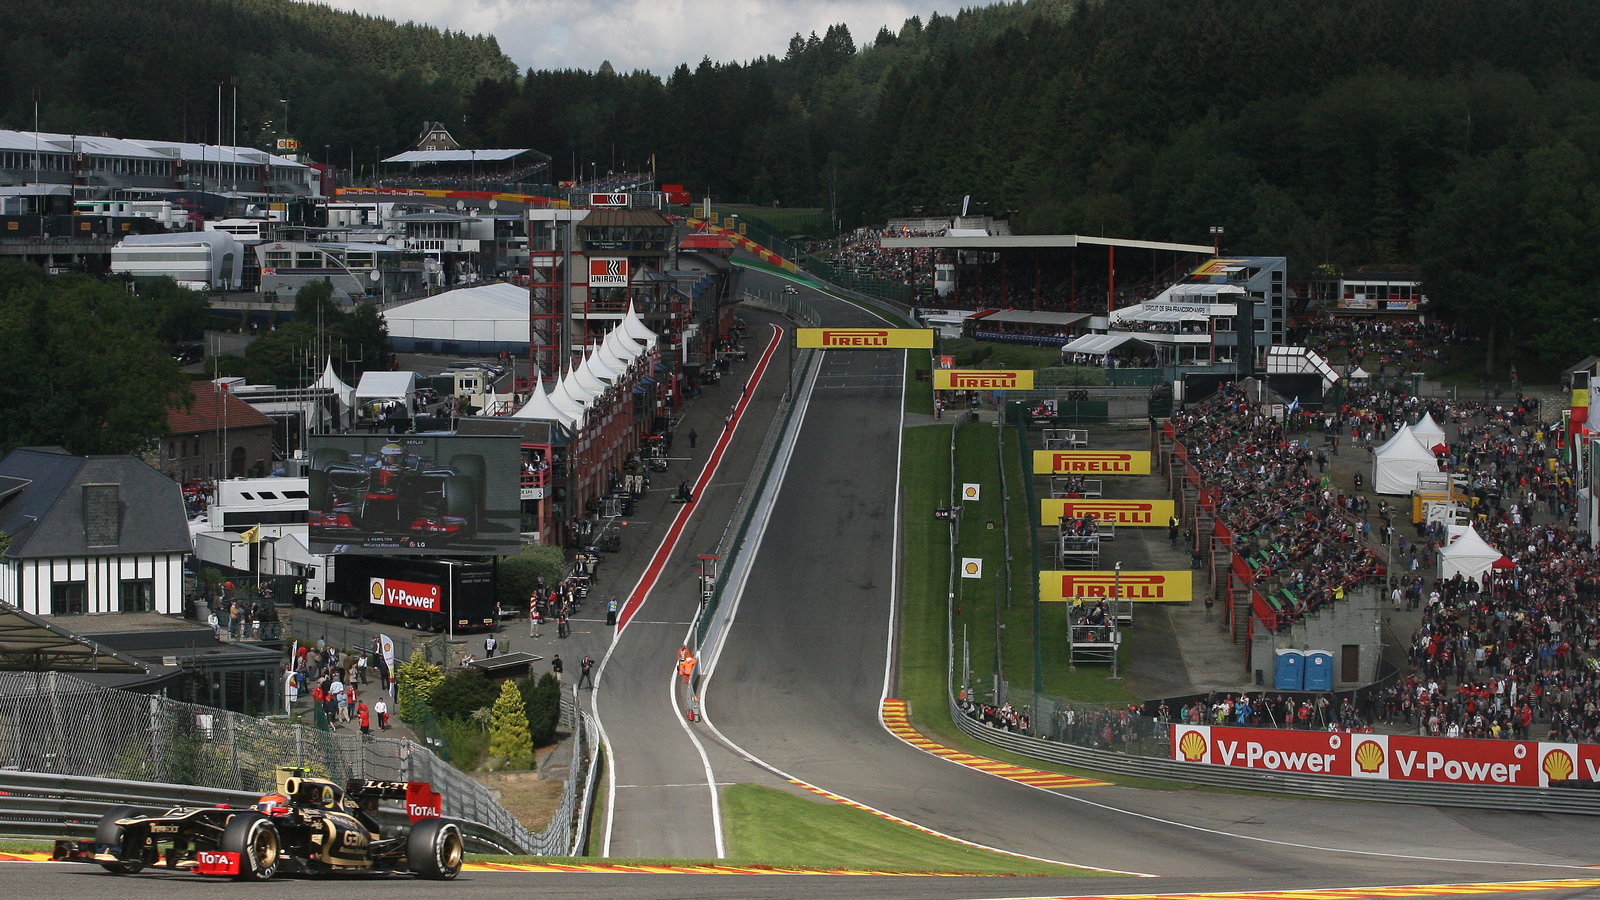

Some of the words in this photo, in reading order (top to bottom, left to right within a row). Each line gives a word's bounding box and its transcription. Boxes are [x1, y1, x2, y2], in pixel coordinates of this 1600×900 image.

[822, 330, 889, 346] PIRELLI
[950, 372, 1017, 388] PIRELLI
[1053, 453, 1132, 472] PIRELLI
[1063, 502, 1153, 524] PIRELLI
[1061, 575, 1166, 598] PIRELLI
[386, 588, 435, 609] V-Power
[1216, 740, 1336, 773] V-Power
[1395, 750, 1521, 783] V-Power
[408, 803, 439, 817] TOTAL
